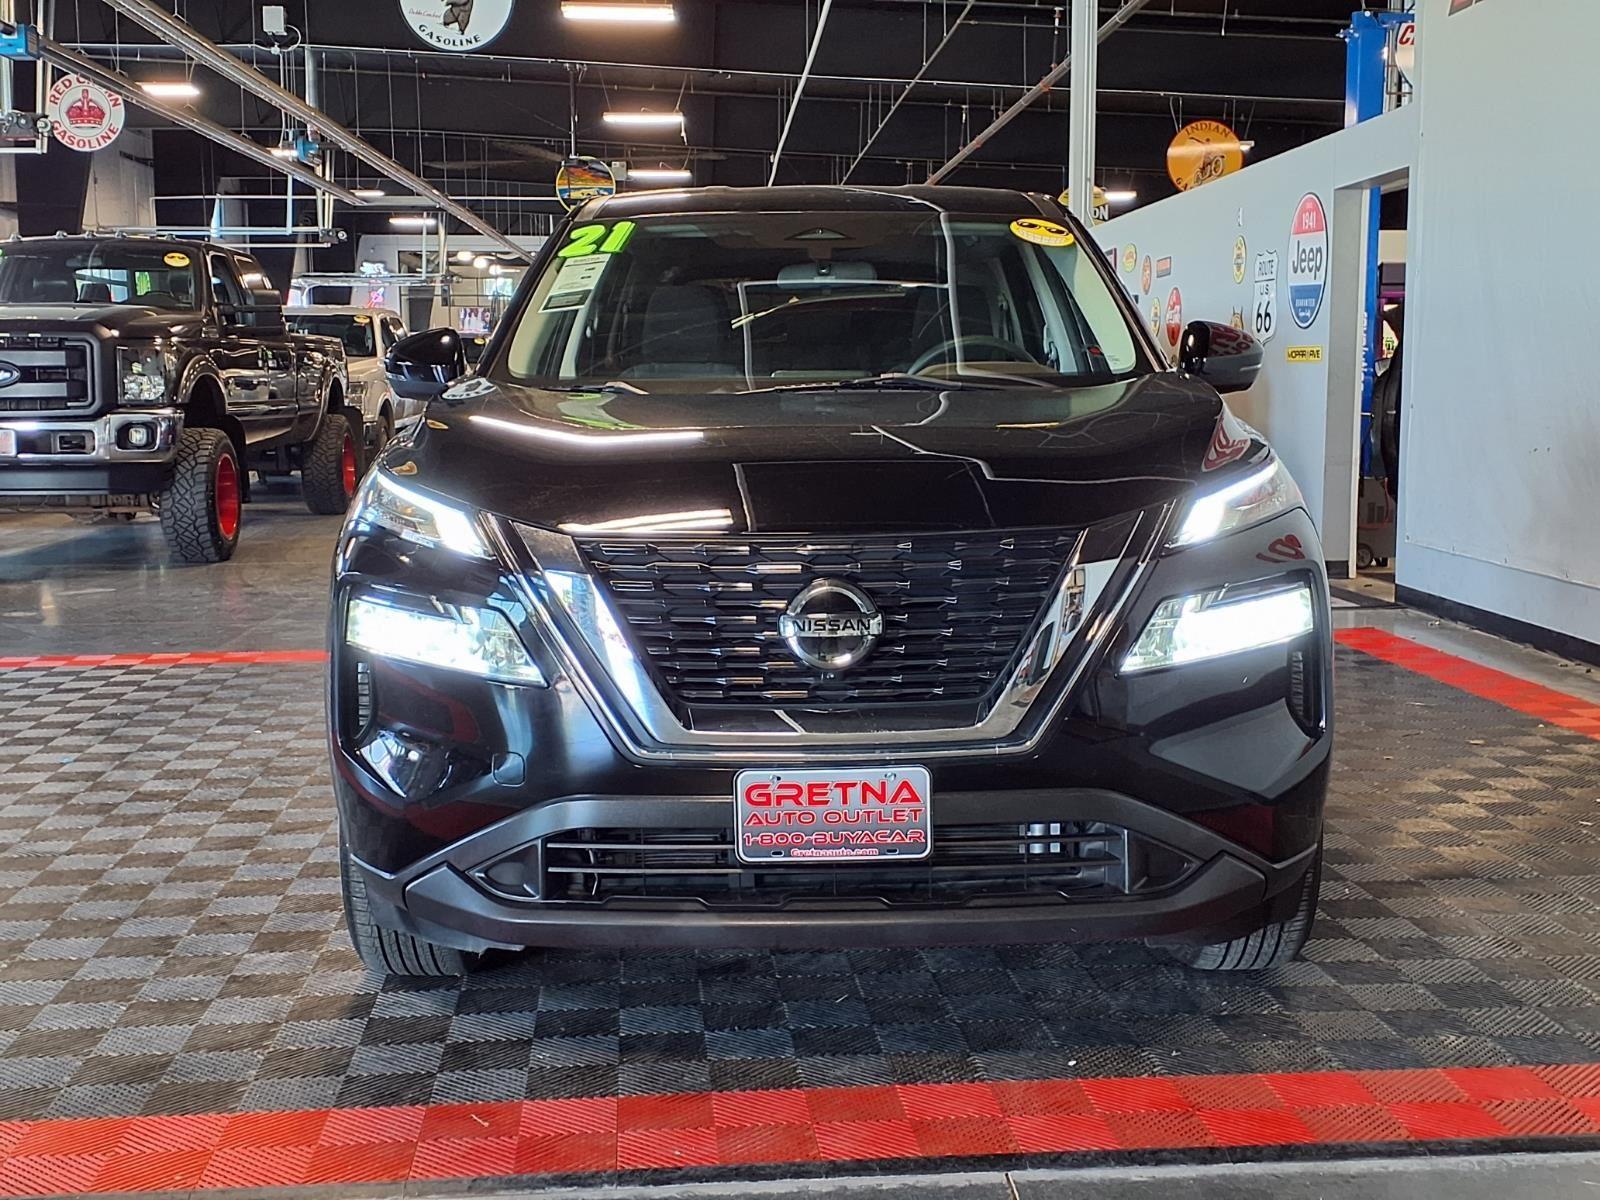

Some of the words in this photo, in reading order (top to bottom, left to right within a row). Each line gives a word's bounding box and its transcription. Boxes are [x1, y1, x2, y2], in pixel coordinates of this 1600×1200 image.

[418, 24, 481, 46] GASOLINE
[49, 78, 73, 105] RED
[52, 120, 119, 149] GASOLINE
[1184, 122, 1231, 139] INDIAN
[1302, 210, 1317, 230] 1941
[557, 221, 636, 257] 21
[1257, 259, 1275, 277] ROUTE
[1292, 240, 1323, 280] Jeep
[1255, 300, 1272, 334] 66
[793, 618, 871, 632] NISSAN
[743, 780, 923, 808] GRETNA
[744, 810, 816, 827] AUTO
[822, 807, 926, 826] OUTLET
[742, 829, 926, 847] 1-800-BUYACAR
